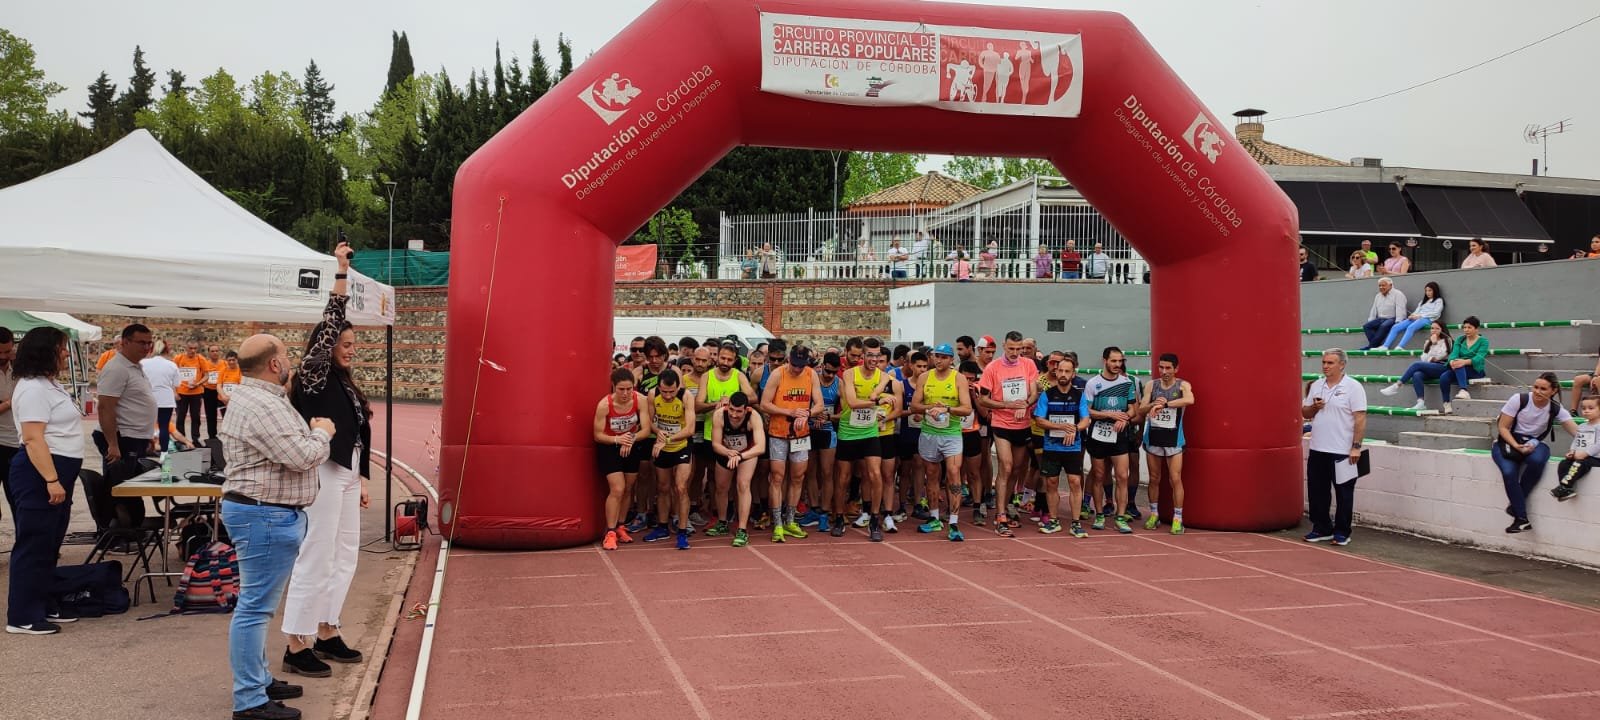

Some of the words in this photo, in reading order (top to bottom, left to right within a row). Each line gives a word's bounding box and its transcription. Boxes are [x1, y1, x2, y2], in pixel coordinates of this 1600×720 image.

[773, 25, 834, 41] CIRCUITO
[840, 30, 916, 47] PROVINCIAL
[921, 35, 936, 48] DE
[773, 39, 850, 57] CARRERAS
[856, 43, 936, 62] POPULARES
[857, 61, 871, 71] DE
[561, 126, 639, 189] Diputación
[638, 110, 657, 129] de
[656, 64, 713, 112] Córdoba
[625, 148, 638, 160] de
[640, 115, 677, 150] Juventud
[682, 79, 721, 113] Deportes
[1123, 94, 1184, 164] Diputación
[1182, 160, 1198, 179] de
[1198, 177, 1242, 228] Córdoba
[1152, 151, 1163, 163] de
[1162, 163, 1194, 197] Juventud
[1199, 201, 1231, 237] Deportes
[1011, 387, 1020, 395] 67
[856, 412, 871, 421] 136
[1156, 414, 1171, 422] 129
[1098, 430, 1112, 438] 217
